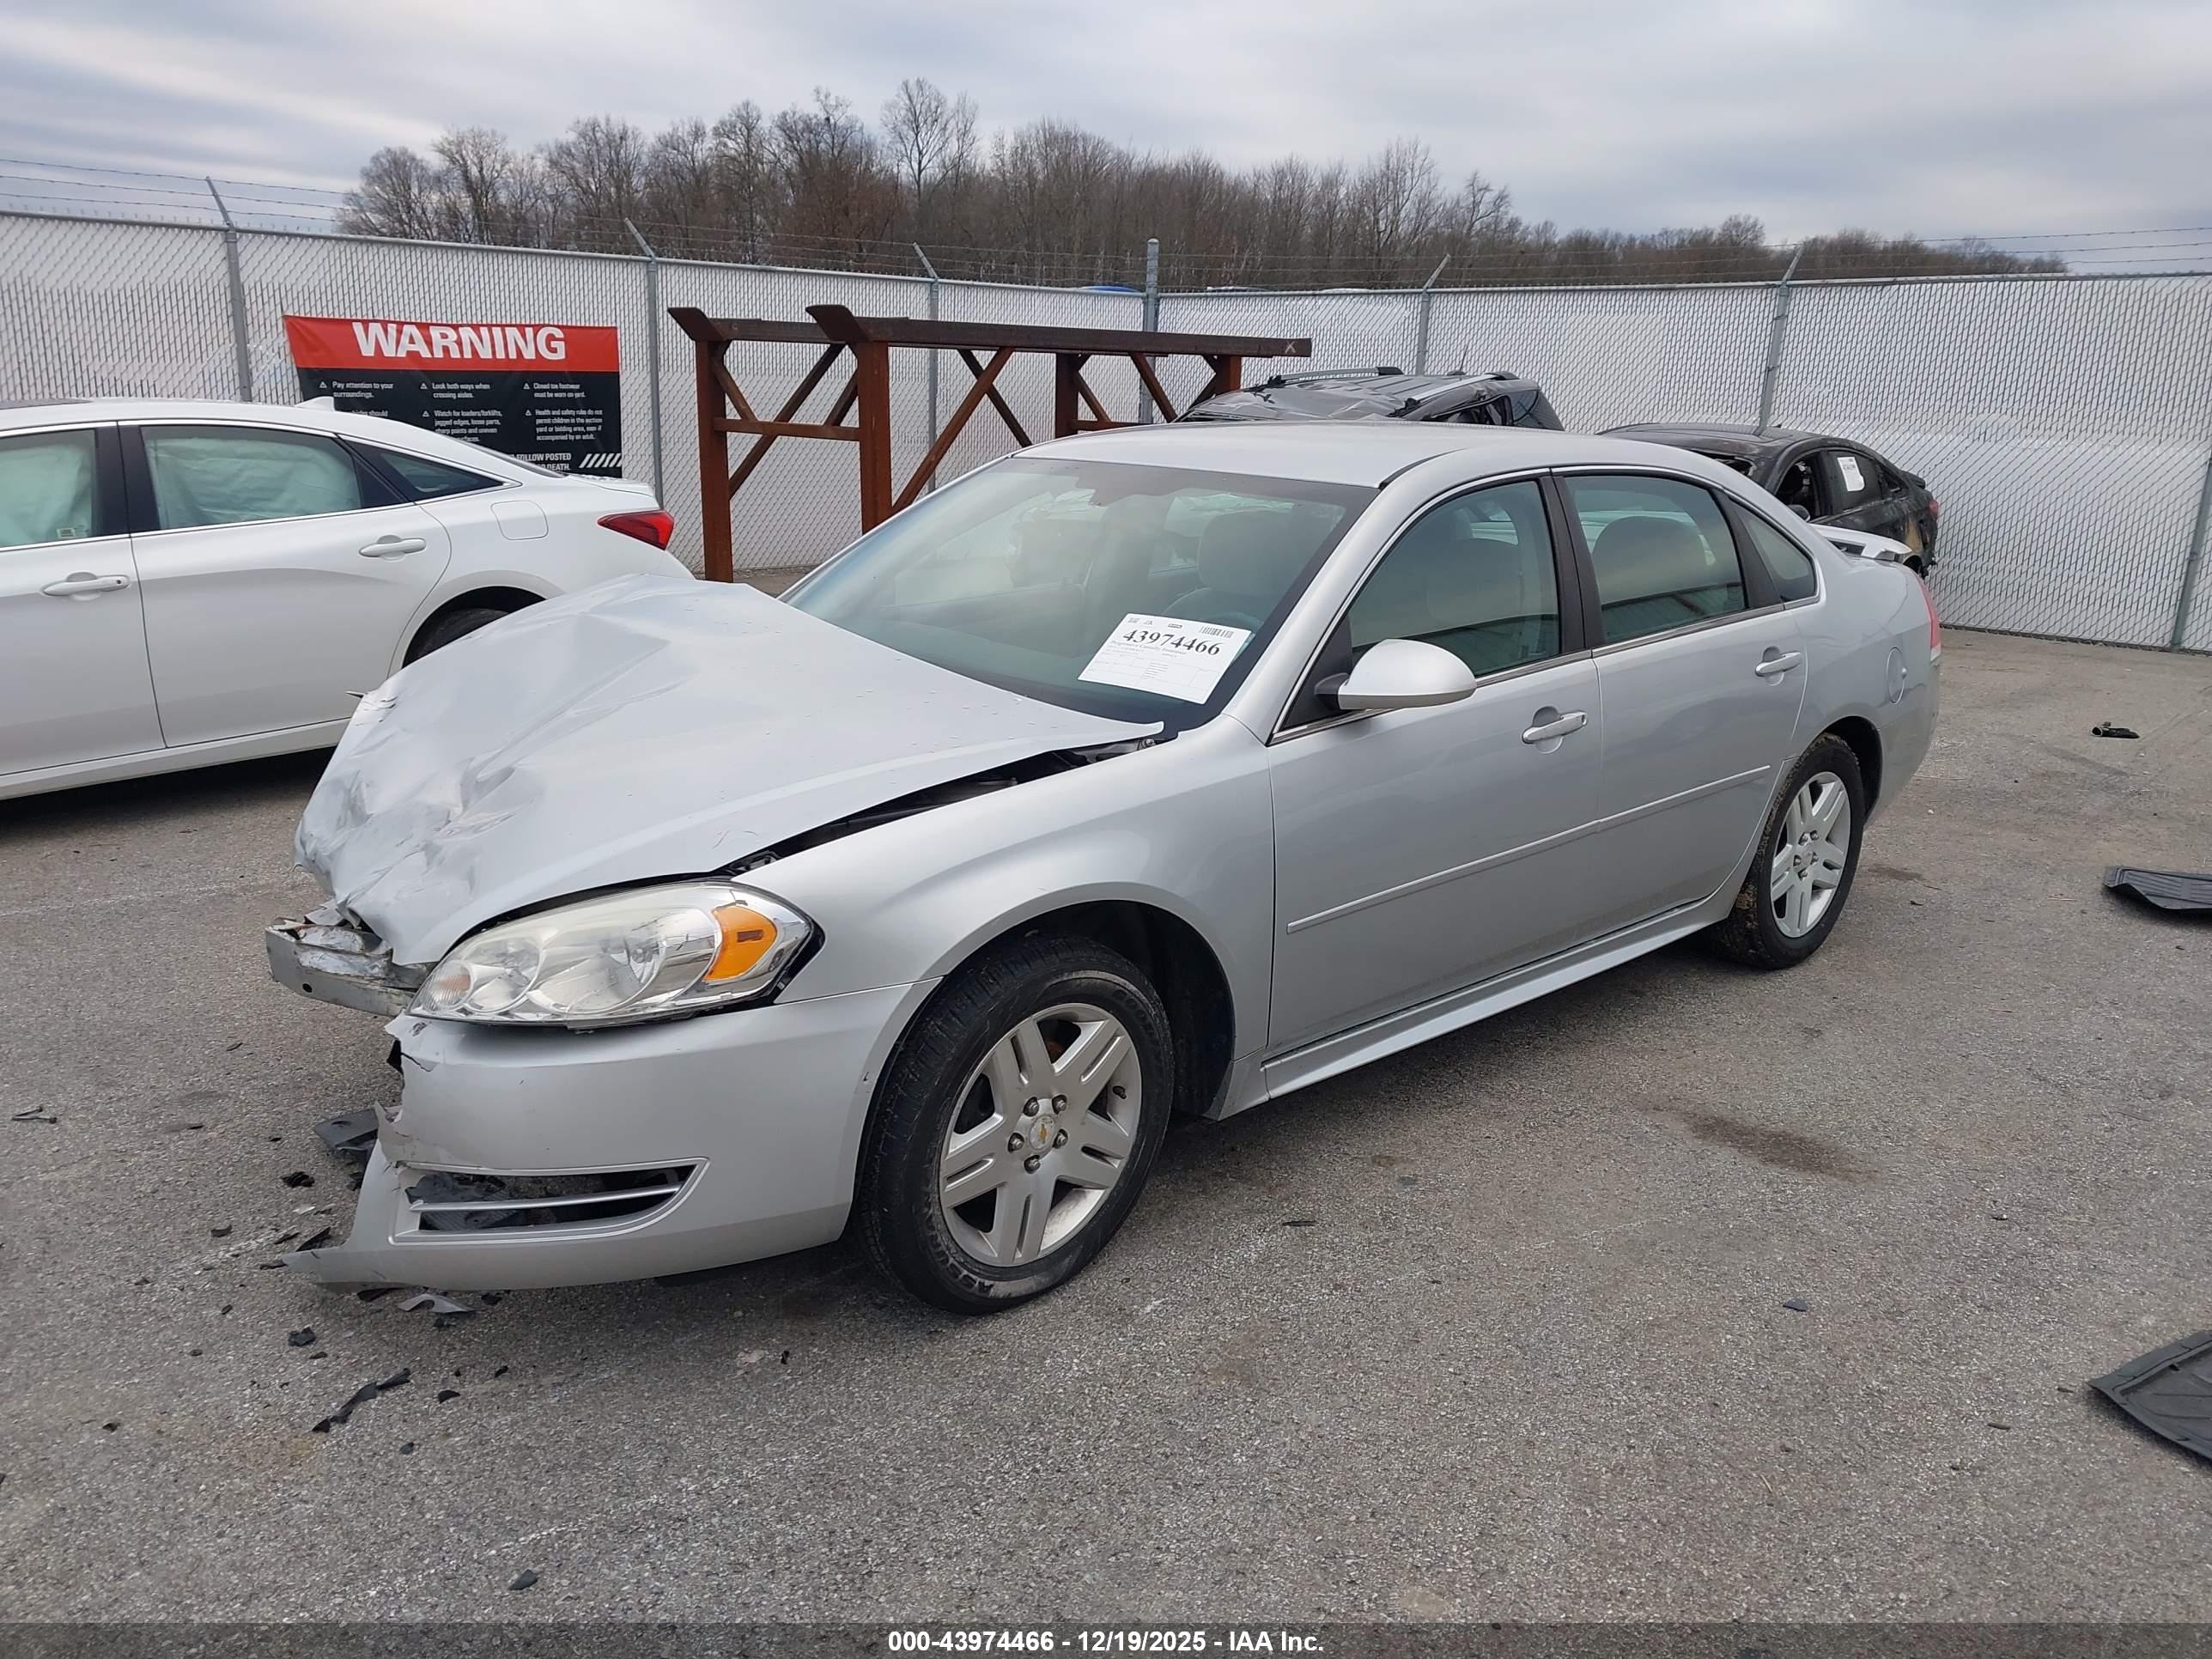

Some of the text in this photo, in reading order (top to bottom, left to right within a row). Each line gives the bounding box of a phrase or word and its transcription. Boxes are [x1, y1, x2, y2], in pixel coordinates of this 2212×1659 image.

[351, 321, 566, 361] WARNING
[516, 453, 544, 462] FOLLOW
[1122, 629, 1224, 656] 43974466
